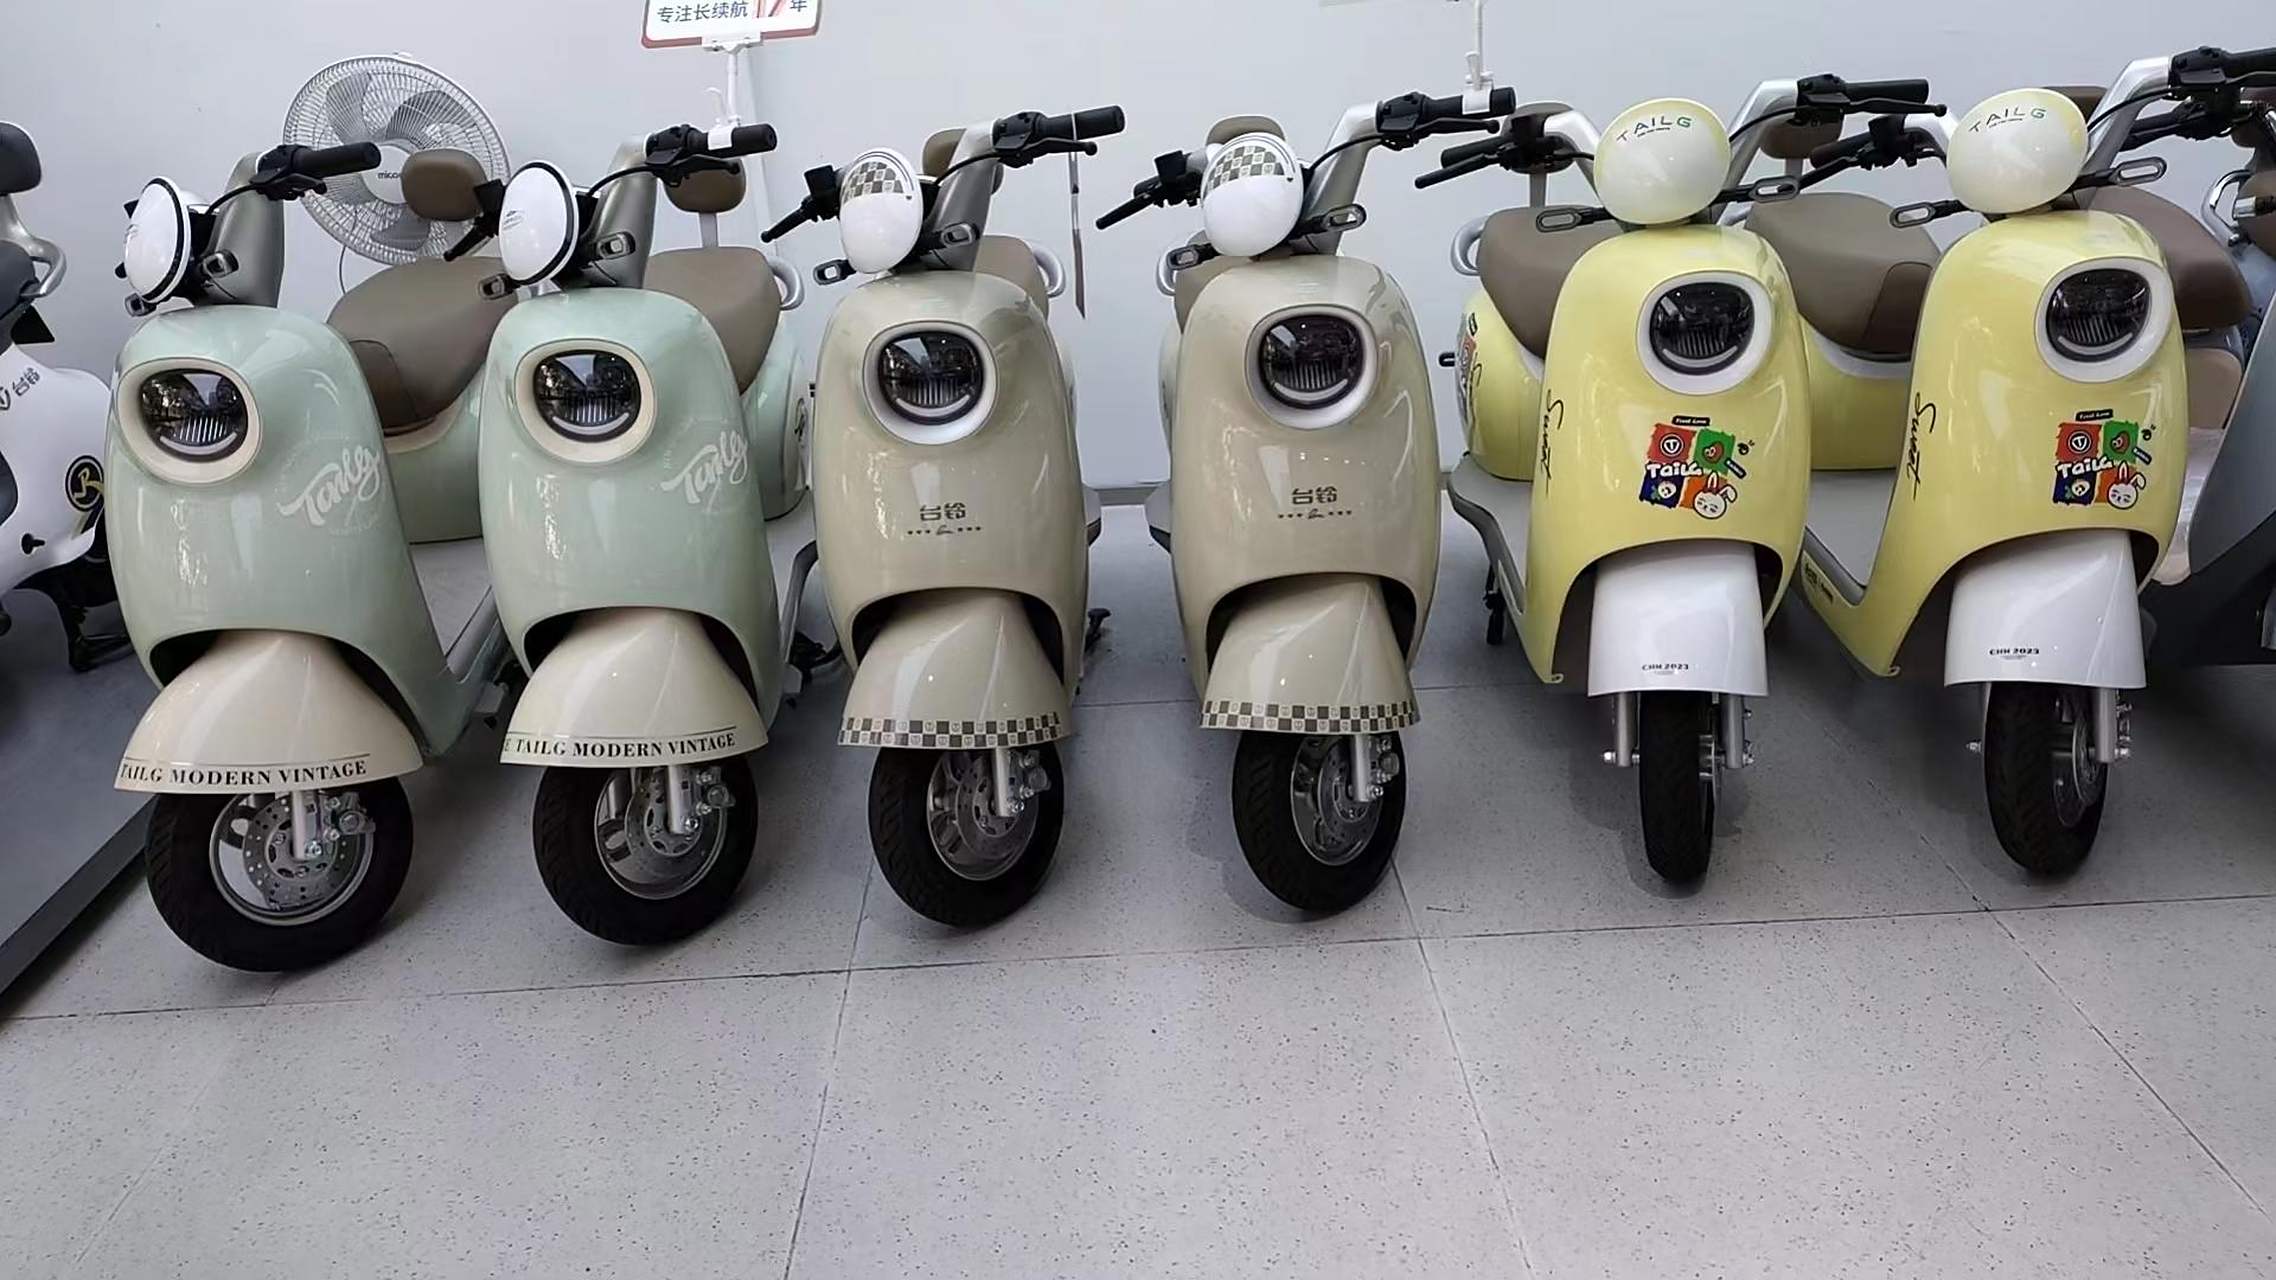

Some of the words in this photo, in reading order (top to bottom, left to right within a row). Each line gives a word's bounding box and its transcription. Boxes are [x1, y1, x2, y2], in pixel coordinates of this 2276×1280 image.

[1615, 115, 1692, 142] TAILG
[1968, 106, 2048, 133] TAILG
[1291, 485, 1338, 505] 台铃
[919, 502, 967, 521] 台铃
[515, 738, 567, 756] TAILG
[573, 740, 663, 758] MODERN
[667, 732, 736, 751] VINTAGE
[119, 762, 163, 783] TAILG
[169, 768, 272, 786] MODERN
[278, 759, 367, 783] VINTAGE
